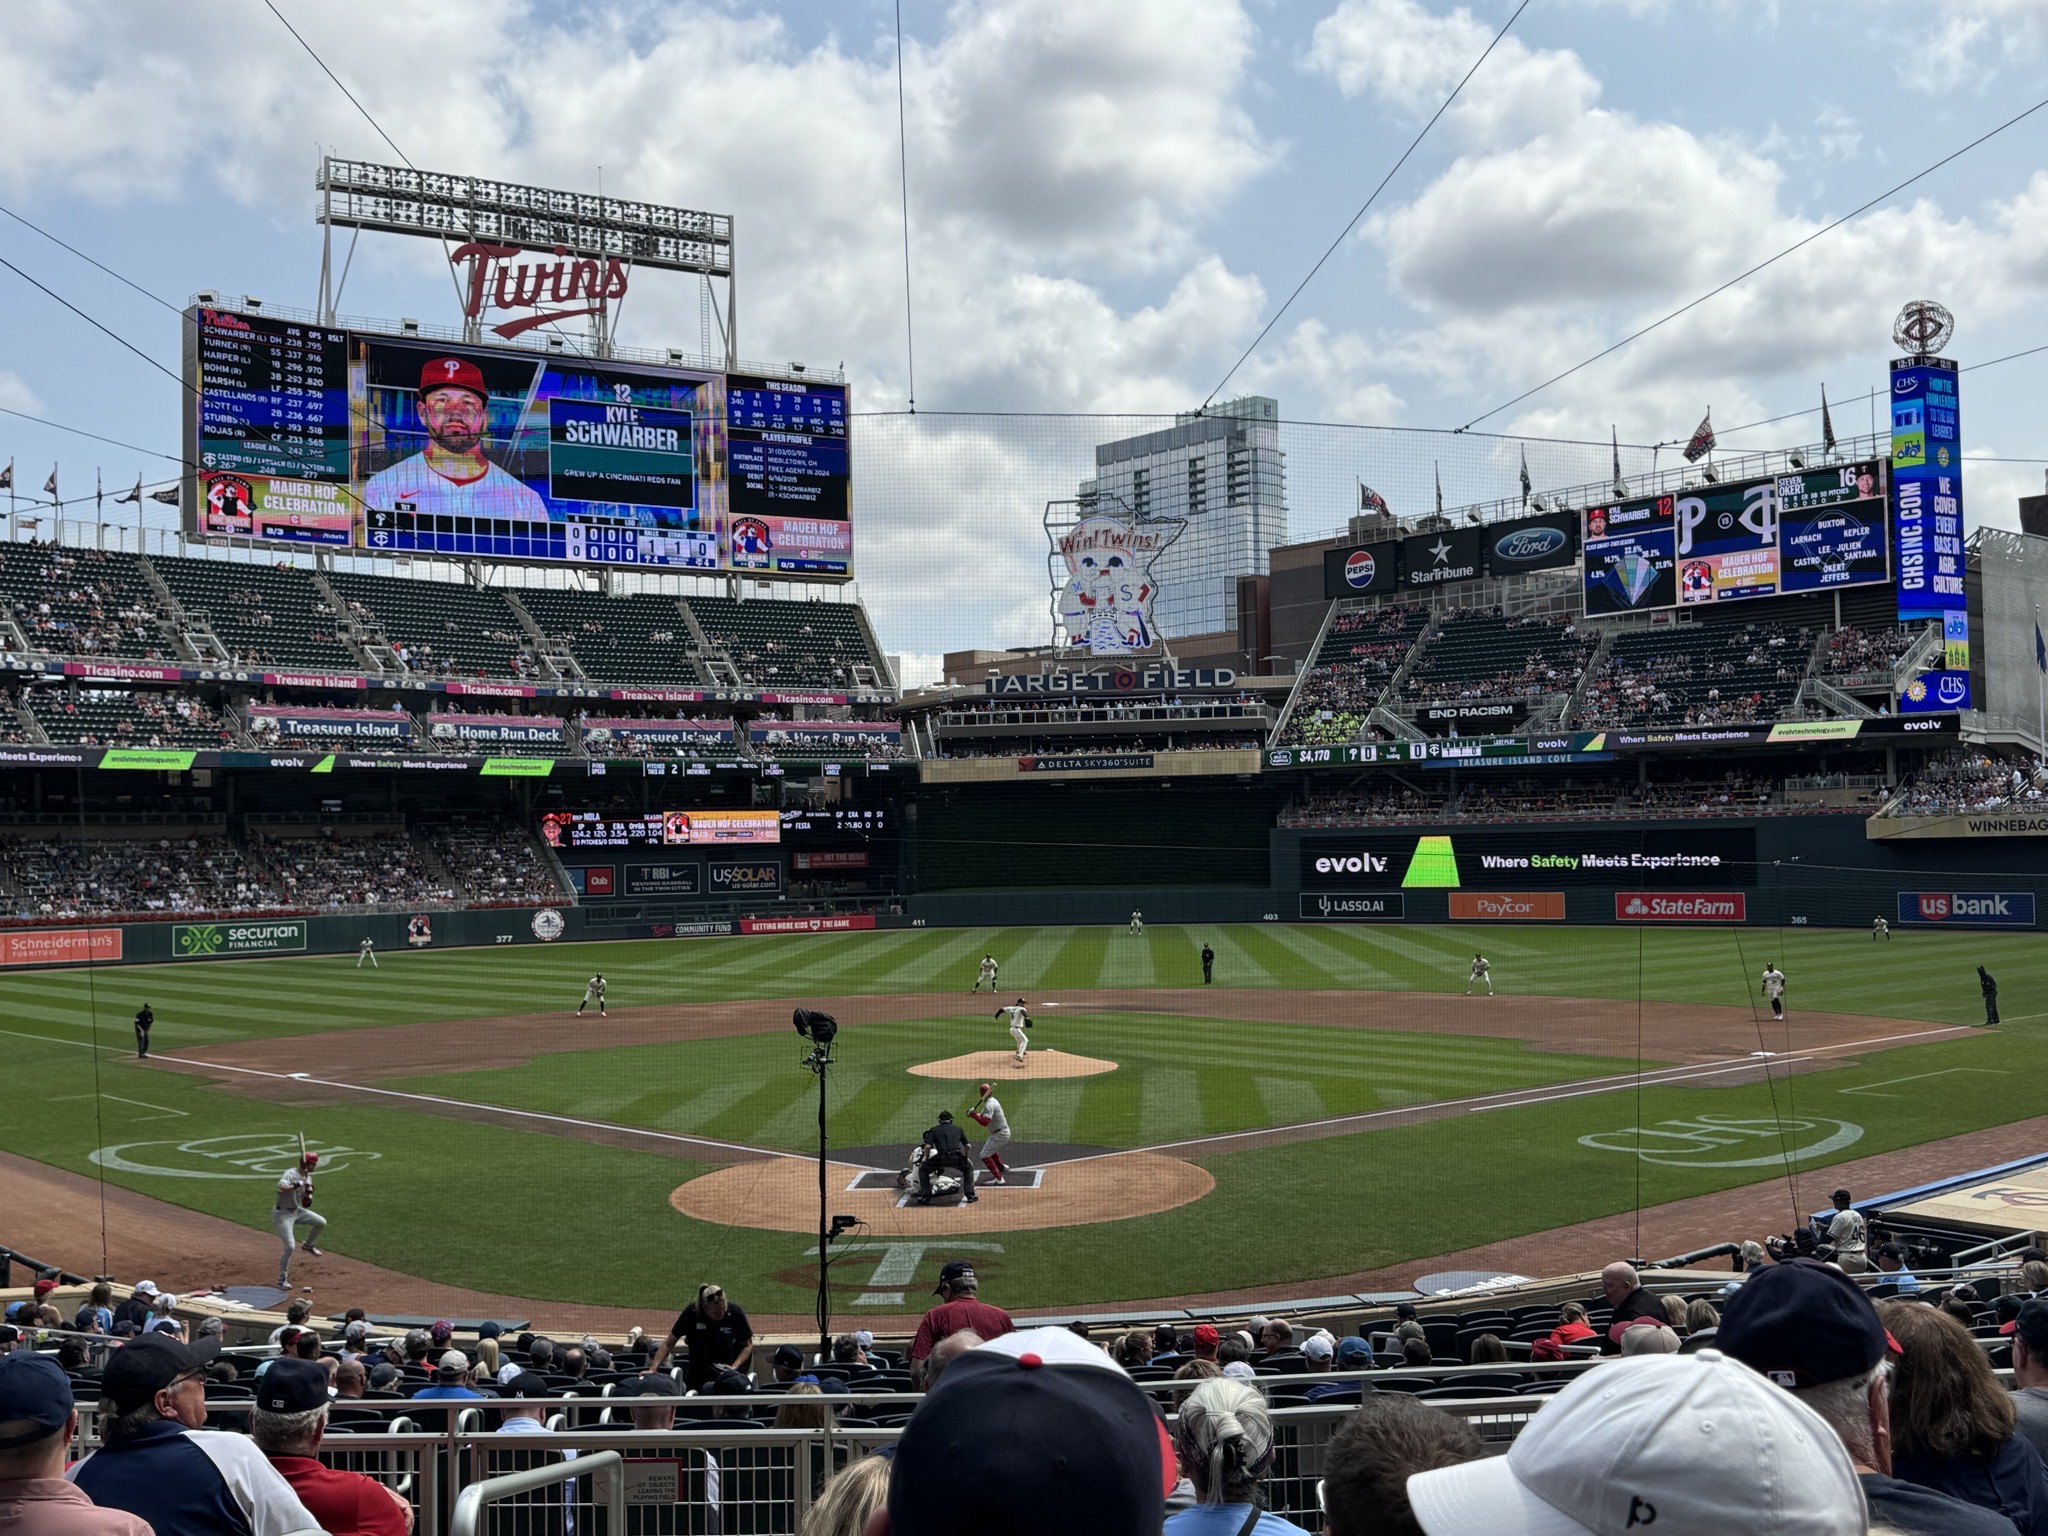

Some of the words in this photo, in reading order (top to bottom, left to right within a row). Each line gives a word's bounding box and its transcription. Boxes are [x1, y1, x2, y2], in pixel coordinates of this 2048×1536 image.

[451, 242, 627, 317] Twins
[204, 326, 255, 340] SCHWARBER
[284, 339, 302, 347] .238
[305, 341, 322, 350] .795
[204, 338, 238, 350] TURNER
[204, 351, 239, 362] HARPER
[1897, 358, 1915, 369] 12:11
[204, 363, 229, 373] BOHM
[204, 376, 235, 385] MARSH
[766, 381, 781, 391] THIS
[781, 383, 806, 393] SEASON
[1896, 376, 1917, 388] CHS
[204, 388, 256, 402] CASTELLANOS
[613, 383, 631, 403] 12
[606, 406, 639, 425] KYLE
[204, 425, 233, 436] ROJAS
[286, 436, 303, 444] .233
[565, 419, 678, 451] SCHWARBER
[762, 432, 785, 442] PLAYER
[786, 435, 812, 445] PROFILE
[564, 469, 585, 477] GREW
[606, 473, 645, 482] CINCINNATI
[647, 476, 666, 484] REDS
[1779, 476, 1802, 487] STEVEN
[1839, 467, 1856, 487] 16
[270, 480, 311, 497] MAUER
[314, 485, 338, 500] HOF
[1779, 483, 1804, 496] OKERT
[1939, 476, 1951, 494] WE
[264, 495, 345, 515] CELEBRATION
[1657, 498, 1672, 515] 12
[1934, 496, 1957, 515] COVER
[1609, 509, 1650, 524] SCHWARBER
[1818, 518, 1845, 529] BUXTON
[266, 527, 284, 535] 8/3
[783, 521, 818, 534] MAUER
[820, 524, 839, 535] HOF
[1936, 516, 1957, 534] EVERY
[779, 533, 844, 549] CELEBRATION
[1058, 529, 1099, 553] Win!
[1102, 529, 1161, 550] Twins!
[1791, 534, 1822, 544] LARNACH
[1844, 527, 1870, 538] KEPLER
[1900, 482, 1924, 590] CHSINC.COM
[1508, 532, 1551, 555] Ford
[1818, 545, 1830, 554] LEE
[1837, 542, 1861, 551] JULIEN
[1934, 536, 1952, 555] BASE
[1952, 537, 1960, 555] IN
[1722, 554, 1751, 567] MAUER
[1752, 552, 1768, 563] HOF
[1794, 556, 1820, 566] CASTRO
[1844, 550, 1876, 561] SANTANA
[1938, 556, 1957, 574] AGRI-
[1347, 564, 1373, 575] PEPSI
[1411, 565, 1473, 584] StarTribune
[1718, 563, 1773, 579] CELEBRATION
[1823, 563, 1845, 572] OKERT
[1820, 572, 1850, 583] JEFFERS
[1933, 575, 1963, 594] CULTURE
[275, 676, 322, 687] Treasure
[325, 676, 357, 689] Island
[985, 673, 1110, 693] TARGET
[1144, 669, 1235, 689] FIELD
[1941, 676, 1964, 694] CHS
[622, 691, 663, 700] Treasure
[665, 692, 694, 701] Island
[1429, 709, 1457, 719] END
[1459, 706, 1513, 718] RACISM
[287, 720, 352, 736] Treasure
[356, 722, 399, 736] Island
[1903, 720, 1941, 731] evolv
[460, 726, 498, 739] Home
[501, 727, 528, 739] Run
[530, 728, 559, 740] Deck
[1619, 734, 1646, 744] Where
[1647, 734, 1674, 743] Safety
[1675, 732, 1701, 741] Meets
[1702, 731, 1749, 741] Experience
[1537, 739, 1568, 749] evolv
[271, 758, 304, 768] evolv
[1049, 760, 1081, 768] DELTA
[1124, 758, 1150, 767] SUITE
[1300, 750, 1330, 762] $4,170
[1458, 757, 1503, 767] TREASURE
[1508, 756, 1542, 765] ISLAND
[1548, 754, 1572, 763] COVE
[350, 760, 376, 769] Where
[377, 761, 401, 771] Safety
[403, 761, 430, 770] Meets
[431, 762, 467, 772] Experience
[560, 813, 571, 824] 27
[584, 813, 600, 821] NOLA
[1315, 853, 1388, 873] evolv
[1481, 855, 1529, 868] Where
[1531, 855, 1578, 870] Safety
[1582, 855, 1629, 868] Meets
[1631, 853, 1721, 868] Experience
[652, 868, 669, 879] RBI
[591, 877, 608, 885] Cub
[1334, 900, 1384, 912] LASSO.AI
[1477, 896, 1532, 914] Paycor
[675, 925, 715, 934] COMMUNITY
[716, 924, 732, 932] FUND
[752, 922, 775, 931] GETTING
[776, 921, 793, 930] MORE
[794, 921, 809, 929] KIDS
[822, 920, 833, 928] THE
[834, 919, 850, 928] GAME
[229, 926, 298, 941] securian
[496, 935, 513, 943] 377
[11, 934, 112, 950] Schneiderman's
[229, 940, 278, 949] FINANCIAL
[1852, 1226, 1865, 1243] 46
